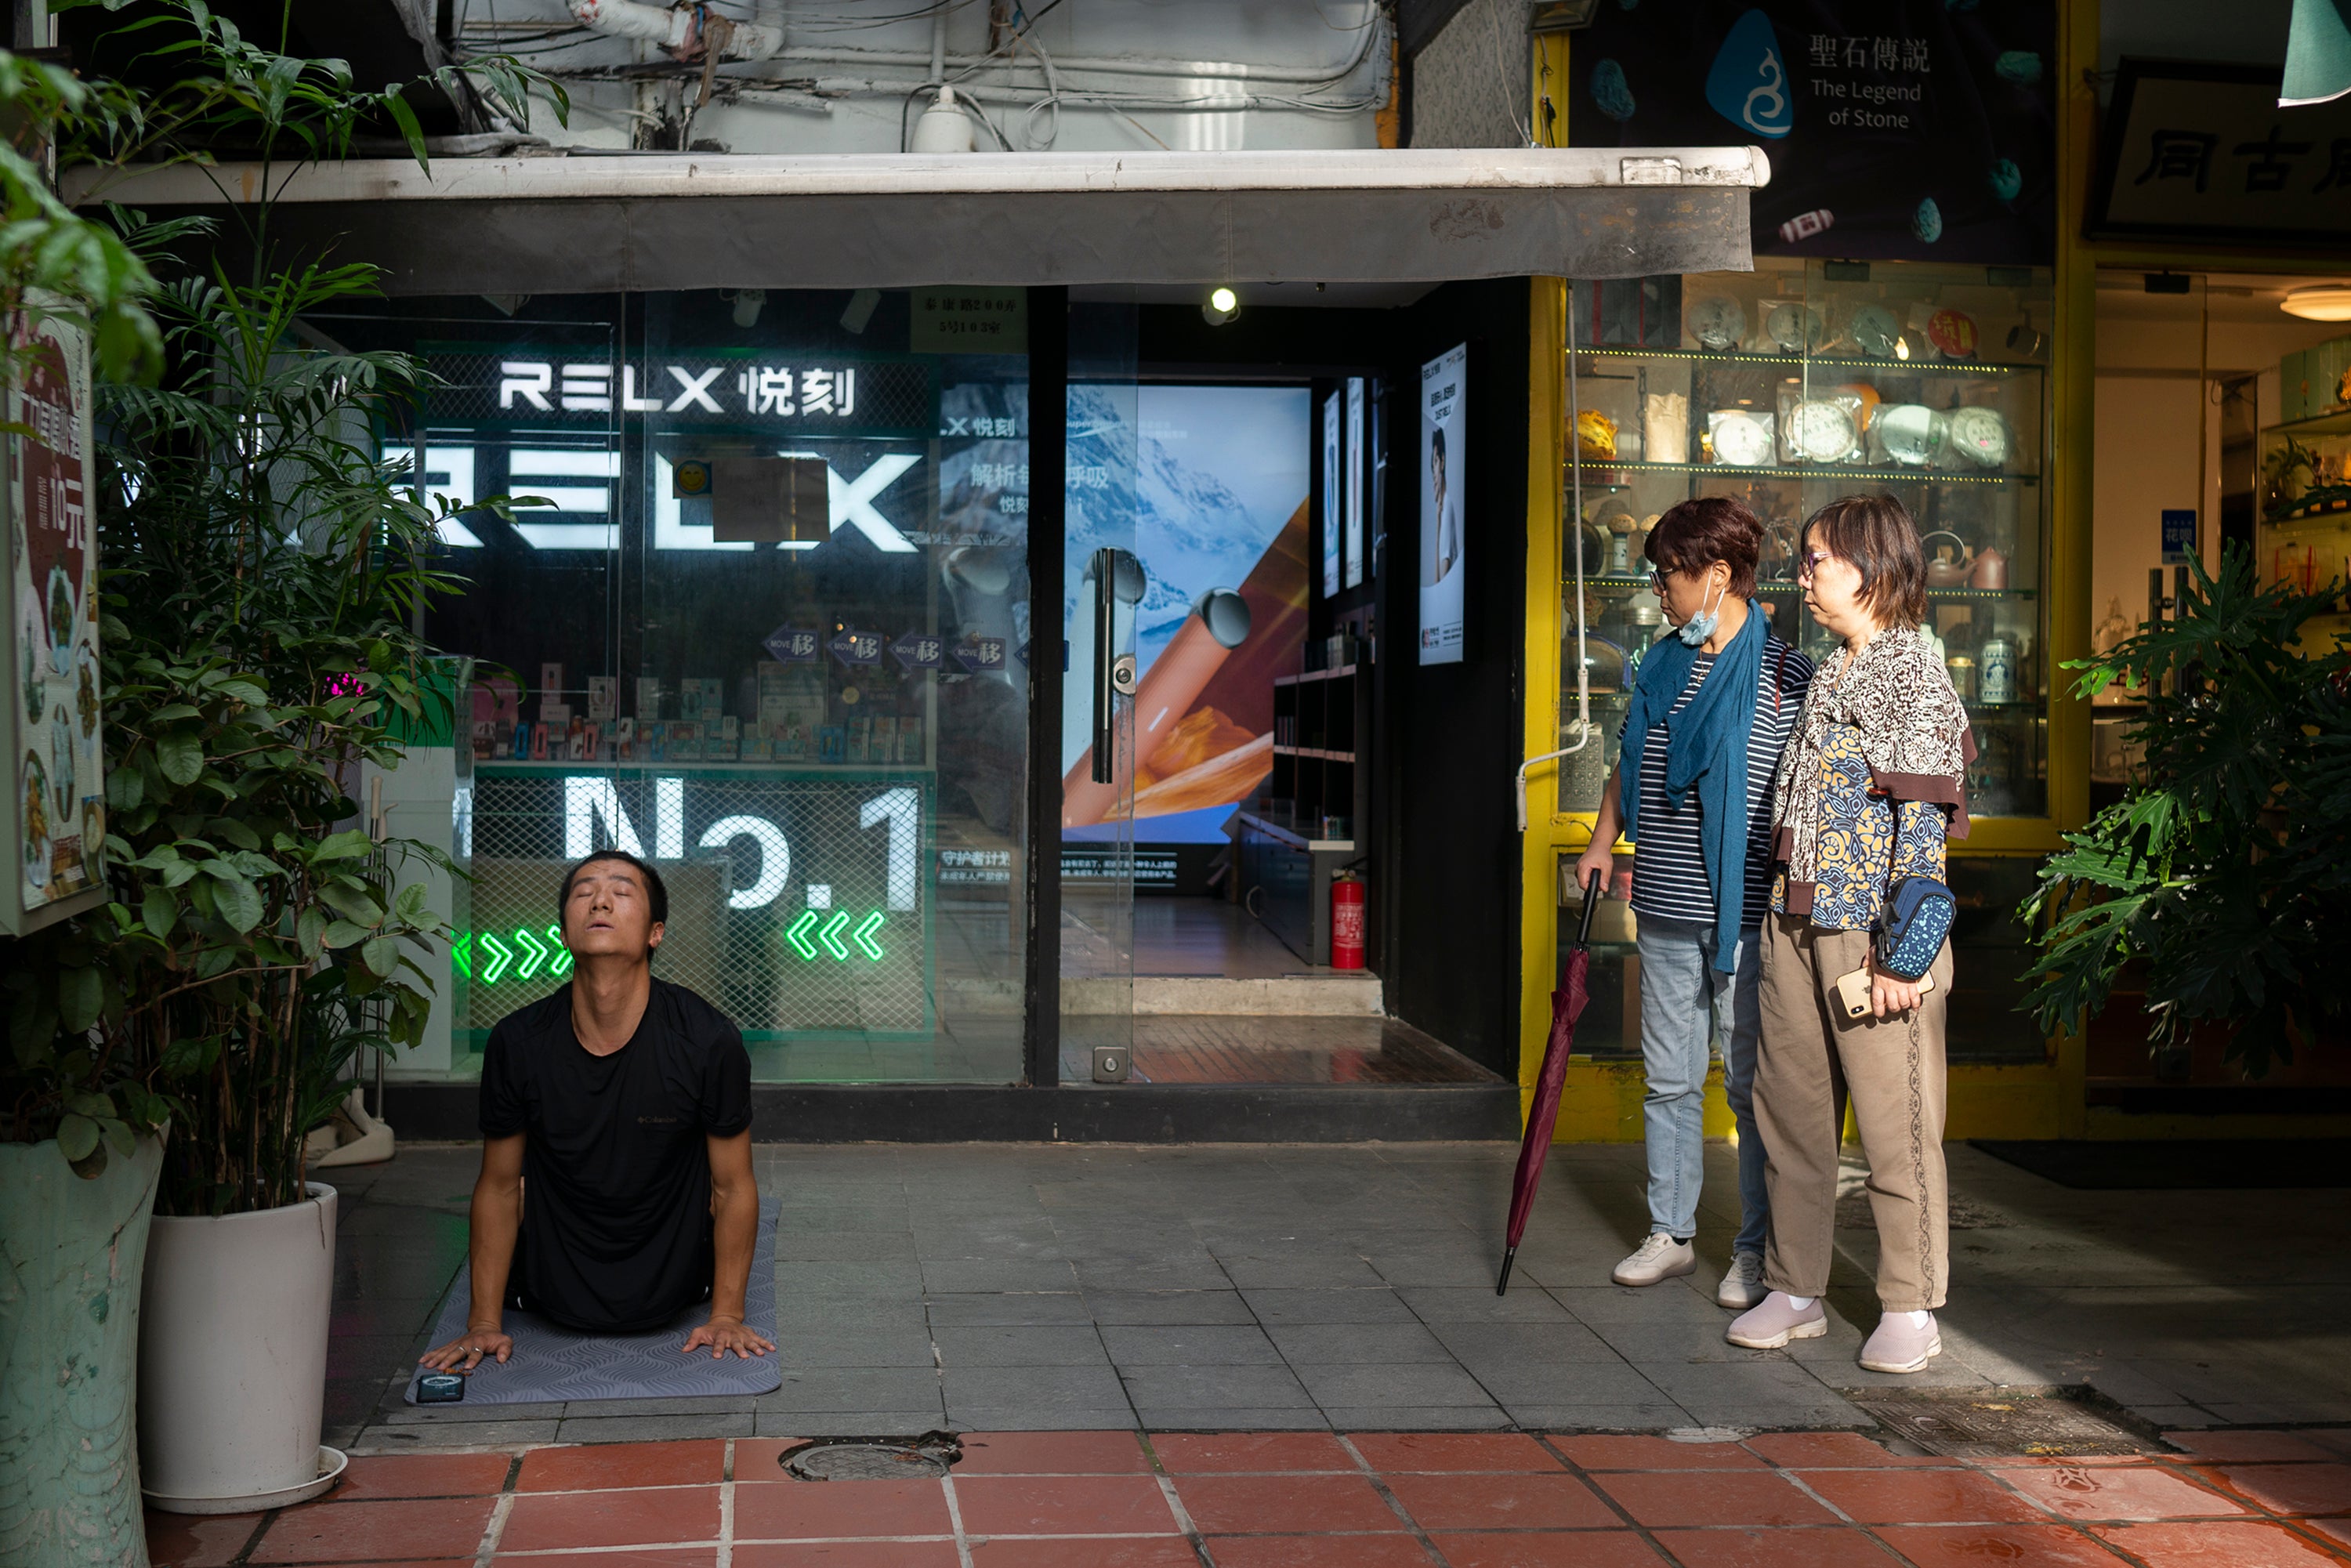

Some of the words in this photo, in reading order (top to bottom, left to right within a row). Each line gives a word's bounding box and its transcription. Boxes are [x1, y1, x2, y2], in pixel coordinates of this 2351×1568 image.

[1811, 78, 1847, 97] The
[1852, 81, 1922, 106] Legend
[1828, 107, 1850, 125] of
[1854, 110, 1910, 129] Stone
[500, 361, 725, 413] RELX
[738, 366, 855, 417] 悦刻
[972, 418, 1016, 437] 悦刻
[770, 639, 791, 650] MOVE
[792, 633, 815, 656] 移
[834, 642, 854, 652] MOVE
[854, 637, 878, 658] 移
[896, 645, 916, 656] MOVE
[916, 639, 940, 662] 移
[958, 646, 978, 657] MOVE
[978, 642, 1002, 664] 移
